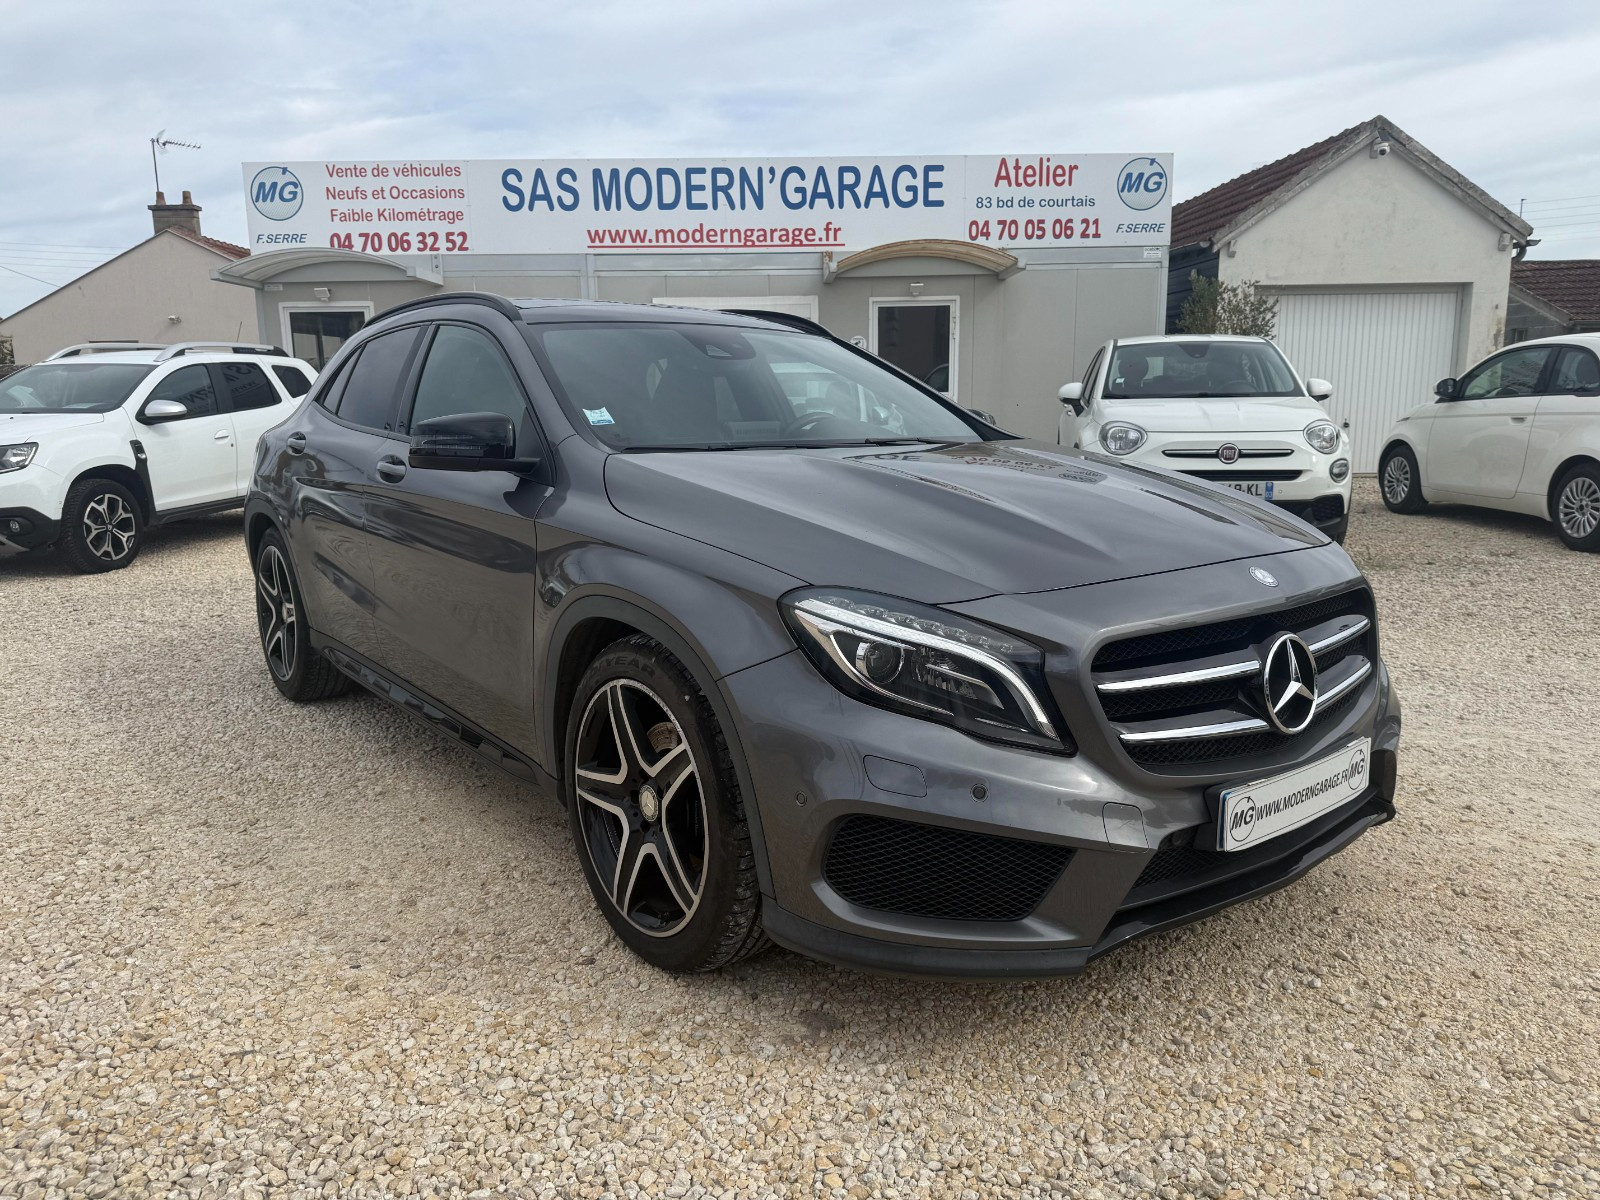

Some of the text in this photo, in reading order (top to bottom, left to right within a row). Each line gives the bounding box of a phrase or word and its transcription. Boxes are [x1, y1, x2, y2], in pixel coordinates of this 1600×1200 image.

[325, 162, 462, 178] Vente de véhicules
[994, 156, 1079, 188] Atelier
[254, 181, 299, 203] MG
[325, 185, 465, 200] Neufs et Occasions
[501, 164, 945, 212] SAS MODERN'GARAGE
[1120, 172, 1164, 193] MG
[975, 195, 1096, 209] 83 bd de courtais
[330, 207, 464, 224] Faible Kilométrage
[256, 233, 307, 244] F.SERRE
[586, 221, 843, 247] www.moderngarage.fr
[968, 217, 1101, 241] 04 70 05 06 21
[1115, 222, 1167, 234] F.SERRE
[330, 231, 469, 252] 04 70 06 32 52
[1230, 758, 1365, 832] MG WWW.MODERNGARAGE.FR MG
